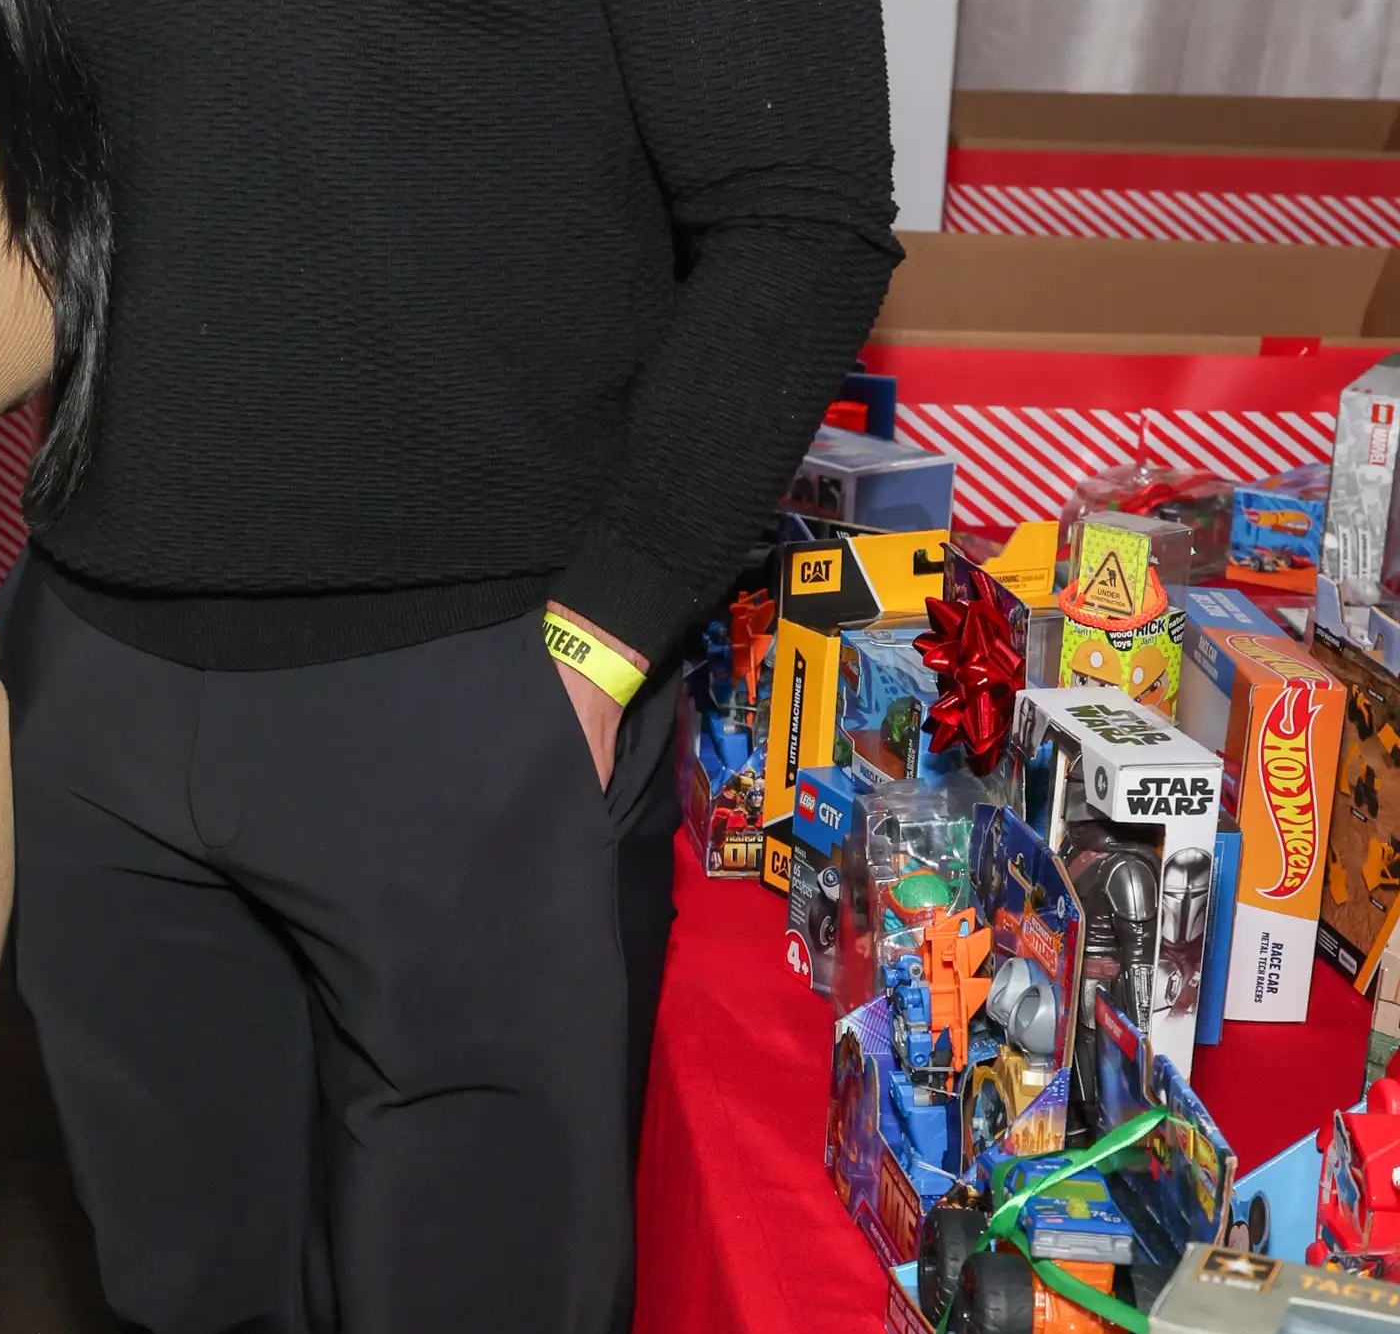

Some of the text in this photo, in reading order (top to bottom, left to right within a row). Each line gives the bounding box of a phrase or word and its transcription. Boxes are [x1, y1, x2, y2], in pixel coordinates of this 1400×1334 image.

[801, 560, 832, 583] CAT
[1097, 588, 1120, 600] UNDER
[1113, 640, 1132, 649] toys
[789, 676, 803, 765] LITTLE MACHINES
[1263, 727, 1309, 795] HOT
[1126, 776, 1215, 797] STAR
[799, 790, 816, 812] LEGO
[1126, 795, 1214, 817] WARS
[818, 801, 844, 830] CITY
[725, 834, 763, 843] TRANSFO
[724, 843, 763, 867] ON
[771, 850, 792, 879] CA
[787, 940, 809, 975] 4+
[1254, 931, 1270, 1004] METAL TECH RACERS
[1266, 942, 1284, 994] RACE CAR
[1300, 1273, 1400, 1308] TACTI
